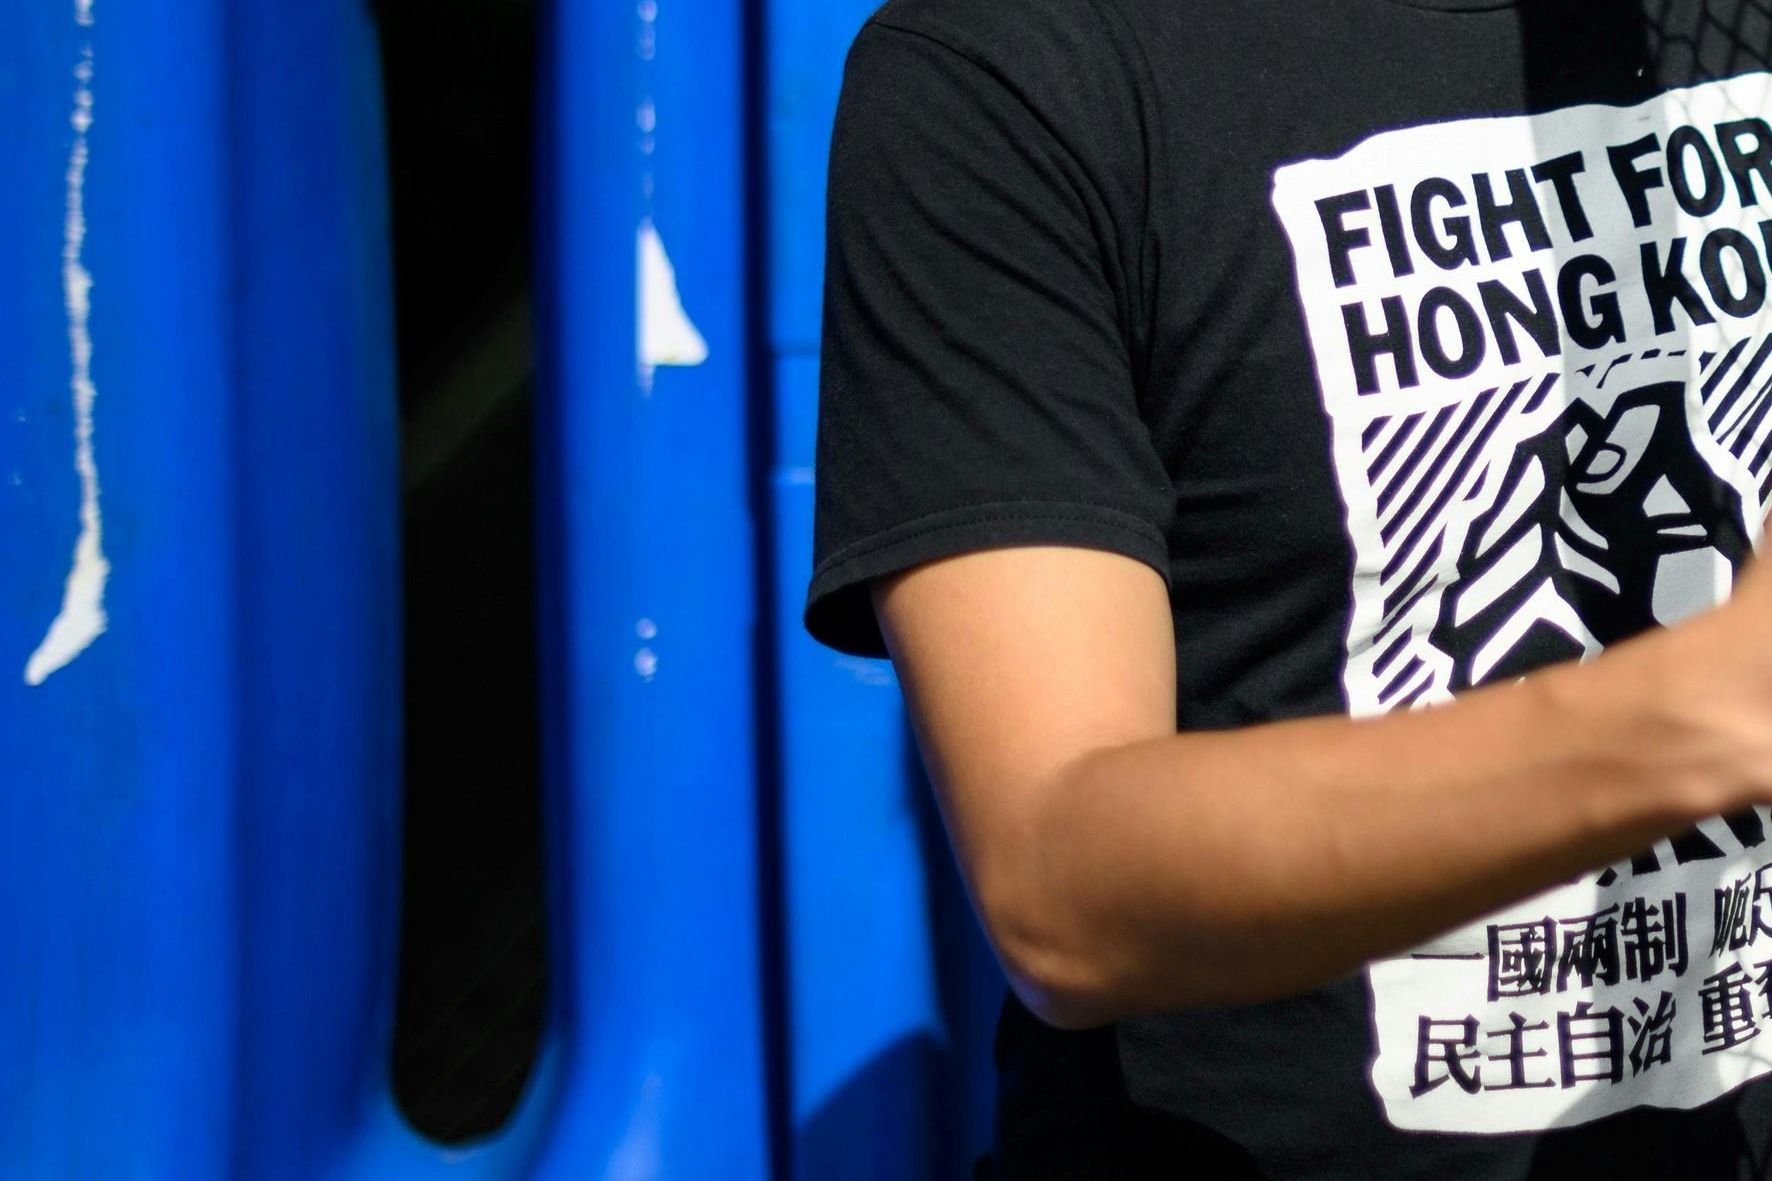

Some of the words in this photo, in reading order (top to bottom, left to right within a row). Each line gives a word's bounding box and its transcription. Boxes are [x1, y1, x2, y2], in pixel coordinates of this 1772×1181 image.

[1315, 151, 1594, 289] FIGHT
[1341, 254, 1626, 396] HONG
[1411, 892, 1688, 1002] 一國兩制
[1409, 991, 1677, 1099] 民主自治
